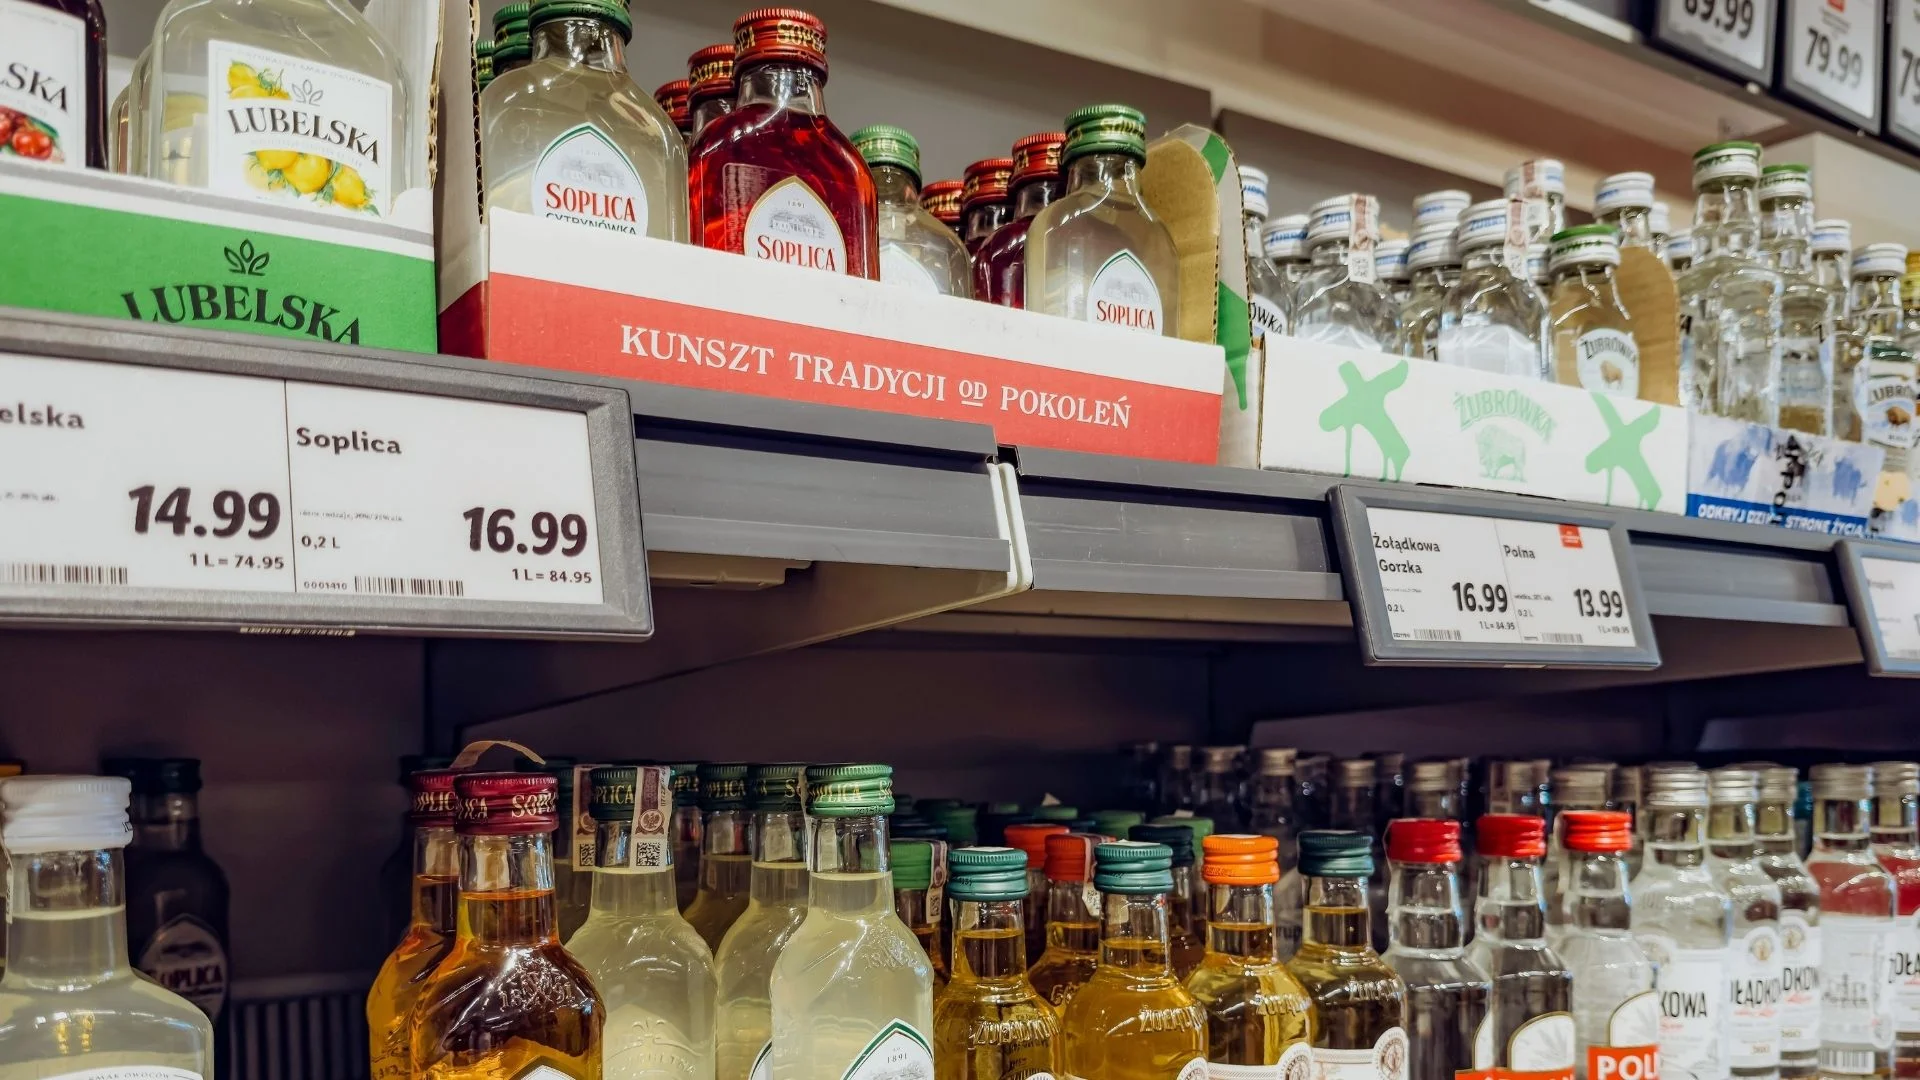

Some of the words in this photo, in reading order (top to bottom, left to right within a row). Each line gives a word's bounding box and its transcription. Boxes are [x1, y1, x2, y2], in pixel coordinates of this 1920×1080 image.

[1806, 27, 1863, 90] 79.99
[0, 61, 67, 112] SKA
[228, 107, 379, 165] LUBELSKA
[546, 182, 637, 222] SOPLICA
[757, 234, 836, 272] SOPLICA
[122, 283, 361, 344] LUBELSKA
[1097, 299, 1155, 330] SOPLICA
[620, 325, 775, 376] KUNSZT
[788, 350, 946, 402] TRADYCJI
[958, 379, 988, 407] OD
[1000, 384, 1131, 429] POKOLEŃ
[1455, 389, 1556, 438] ŻUBRÓWKA
[296, 427, 402, 455] Soplica
[128, 484, 281, 540] 14.99
[1698, 503, 1747, 523] ODKRYJ
[301, 535, 327, 549] 0,2
[332, 536, 340, 549] L
[463, 506, 588, 557] 16.99
[1373, 532, 1440, 553] Żołądkowa
[234, 554, 285, 569] 74.95
[1379, 559, 1423, 574] Gorzka
[1503, 545, 1536, 559] Polna
[549, 570, 592, 584] 84.95
[1452, 582, 1508, 613] 16.99
[1573, 588, 1623, 619] 13.99
[887, 1053, 908, 1064] 1891
